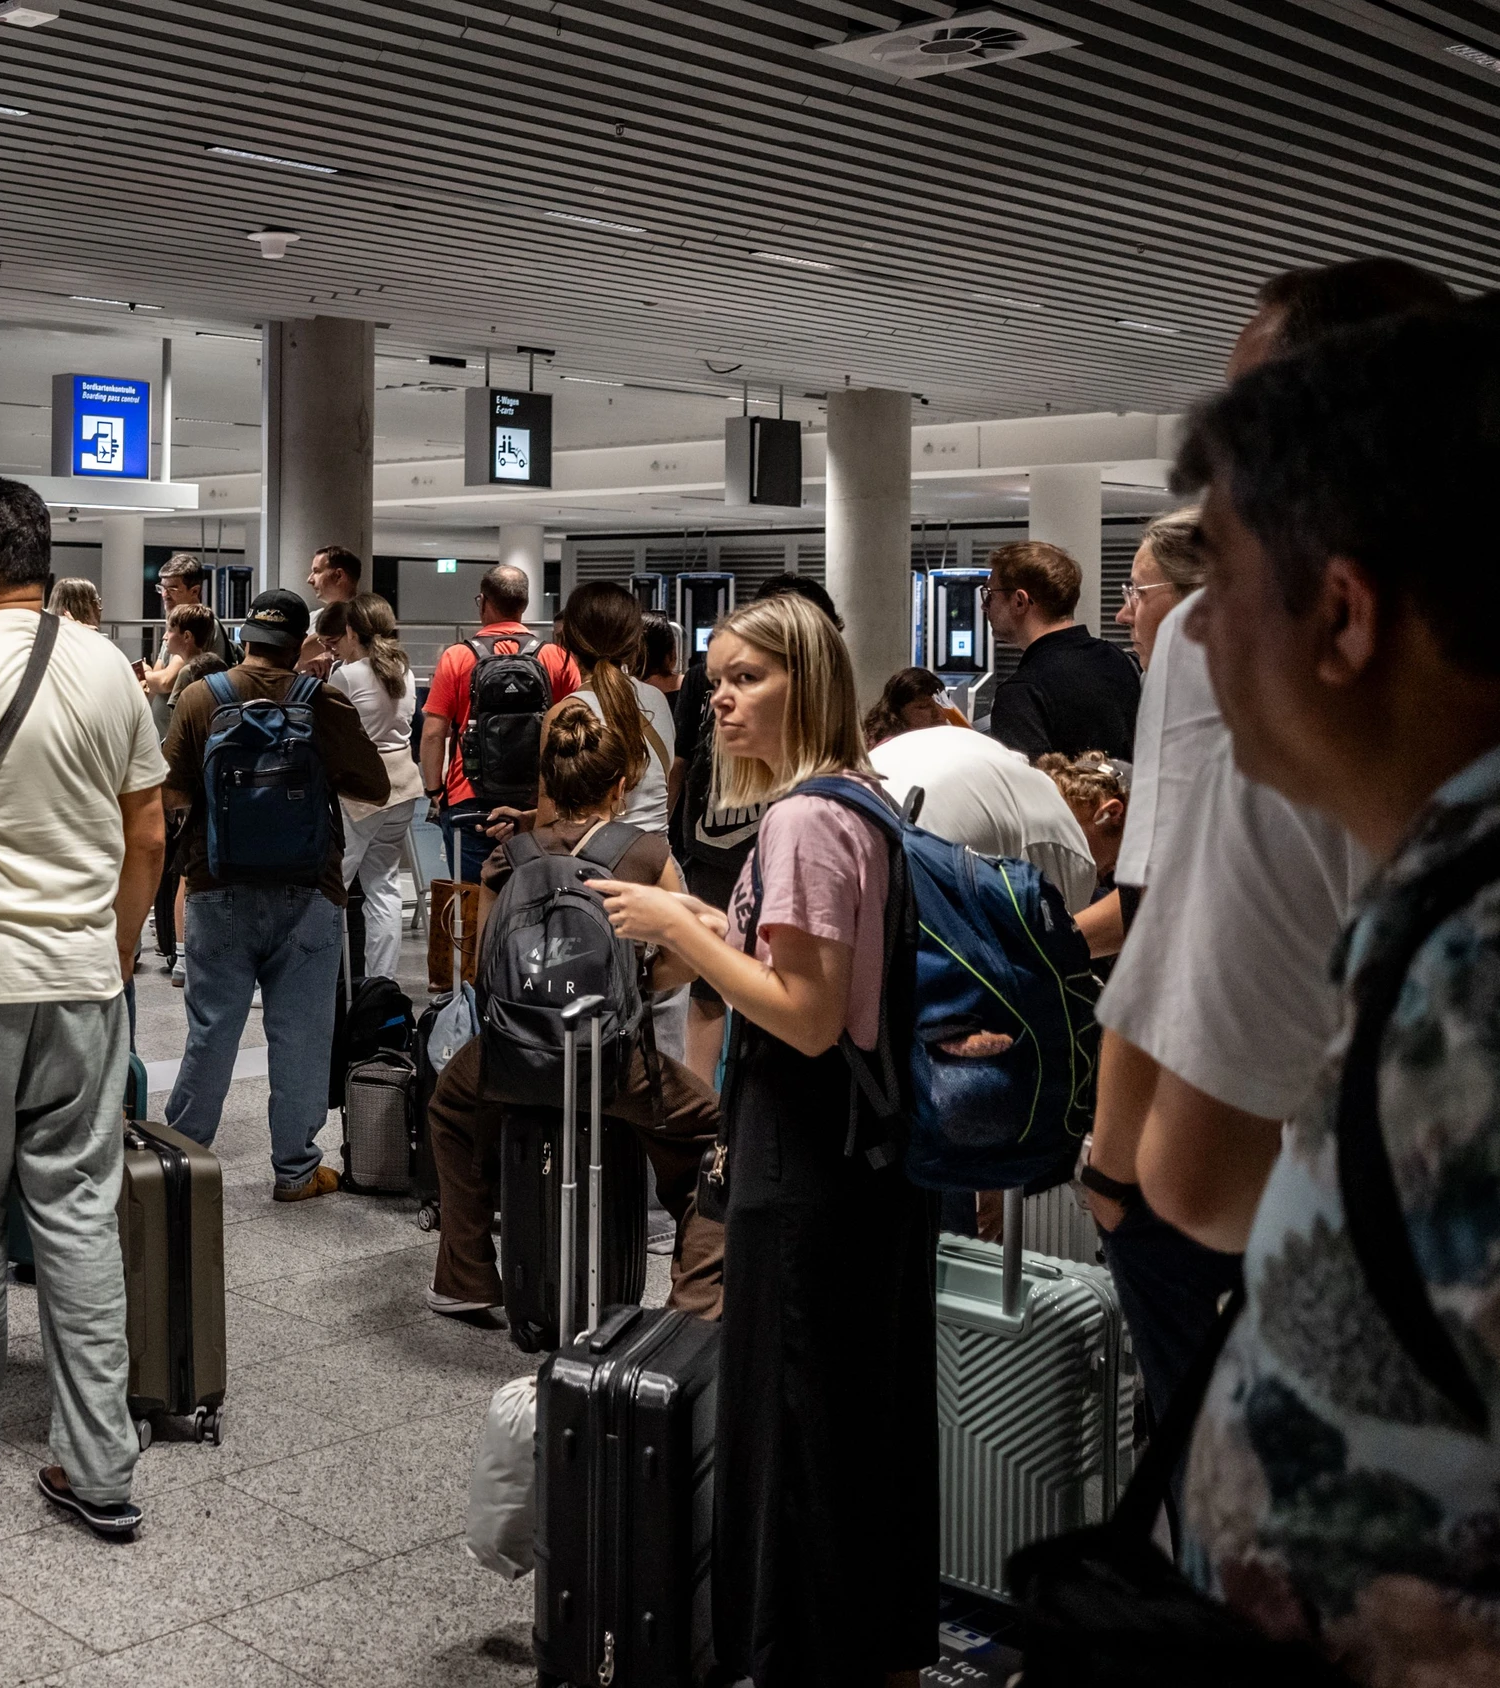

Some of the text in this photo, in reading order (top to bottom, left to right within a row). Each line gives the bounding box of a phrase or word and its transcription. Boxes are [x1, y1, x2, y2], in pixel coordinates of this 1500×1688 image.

[82, 381, 136, 395] Bordkartenkontrolle
[82, 391, 107, 403] Boarding
[121, 396, 140, 404] control
[496, 395, 520, 407] E-Wagen
[495, 405, 515, 415] E-carts
[523, 977, 575, 994] AIR
[952, 1661, 988, 1679] for
